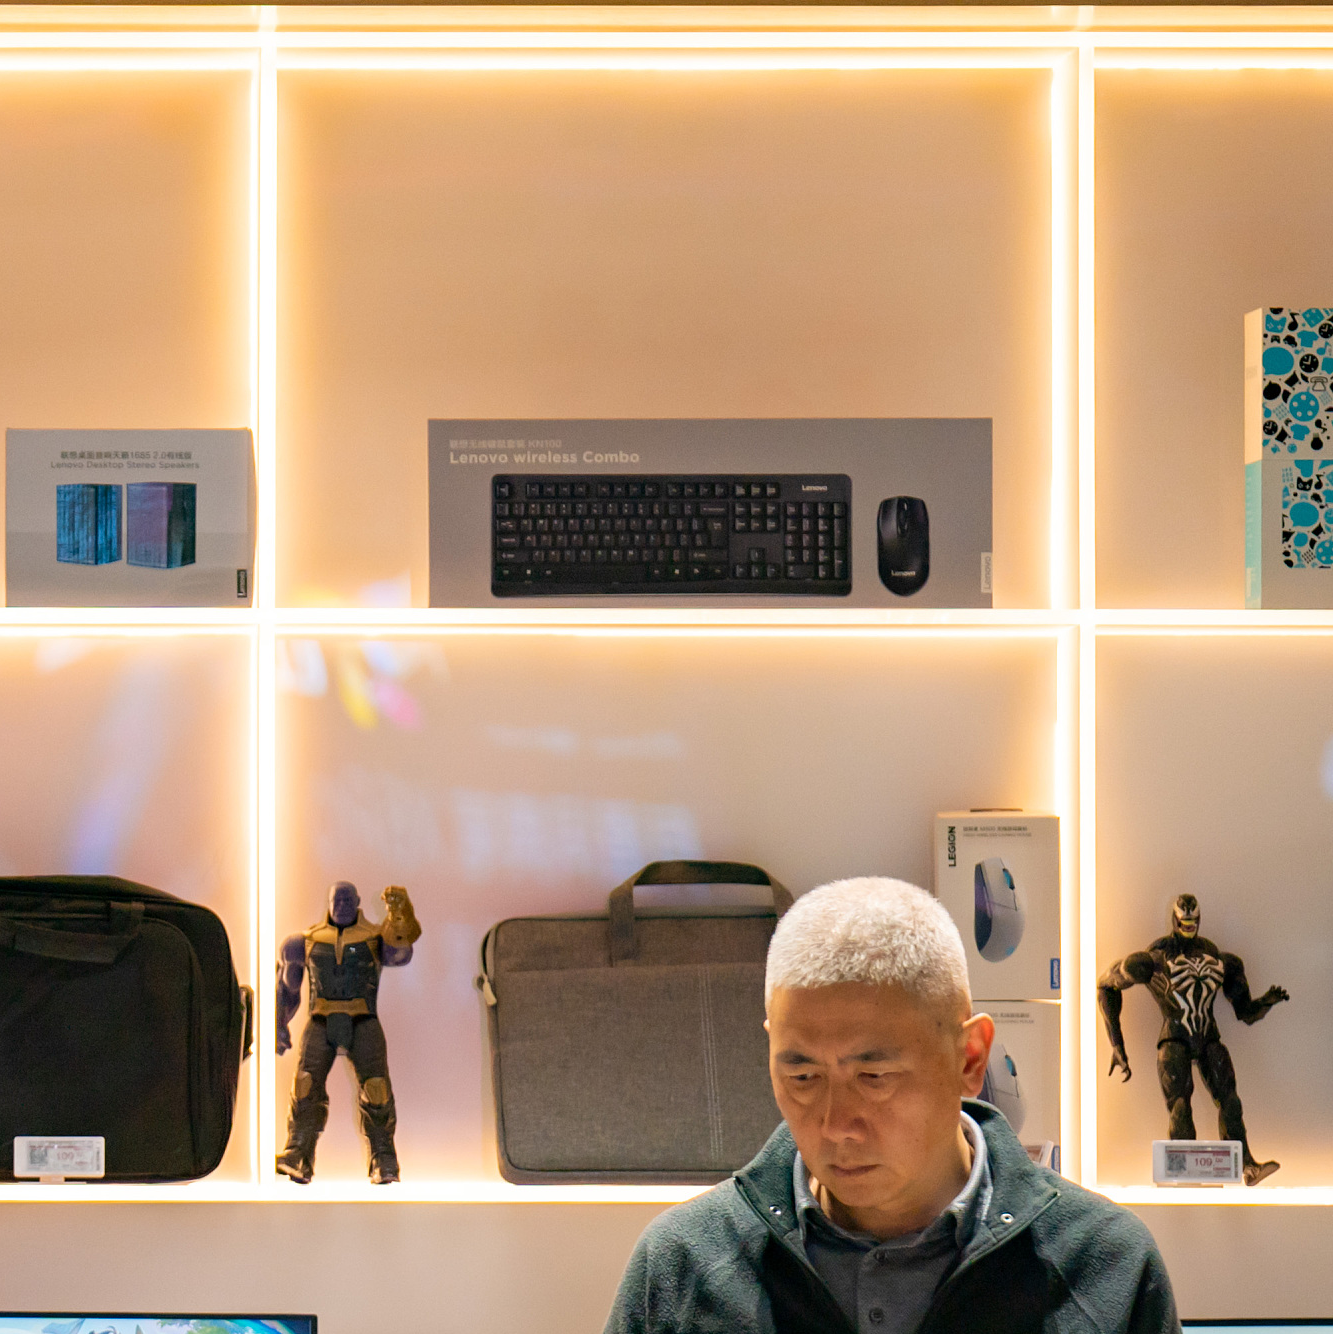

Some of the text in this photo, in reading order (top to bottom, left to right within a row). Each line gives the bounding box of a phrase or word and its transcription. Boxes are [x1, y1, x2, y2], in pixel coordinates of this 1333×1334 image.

[449, 450, 640, 464] Lenovo wireless Combo
[86, 461, 124, 469] Desktop
[159, 461, 200, 469] Speakers
[947, 825, 957, 868] LEGION
